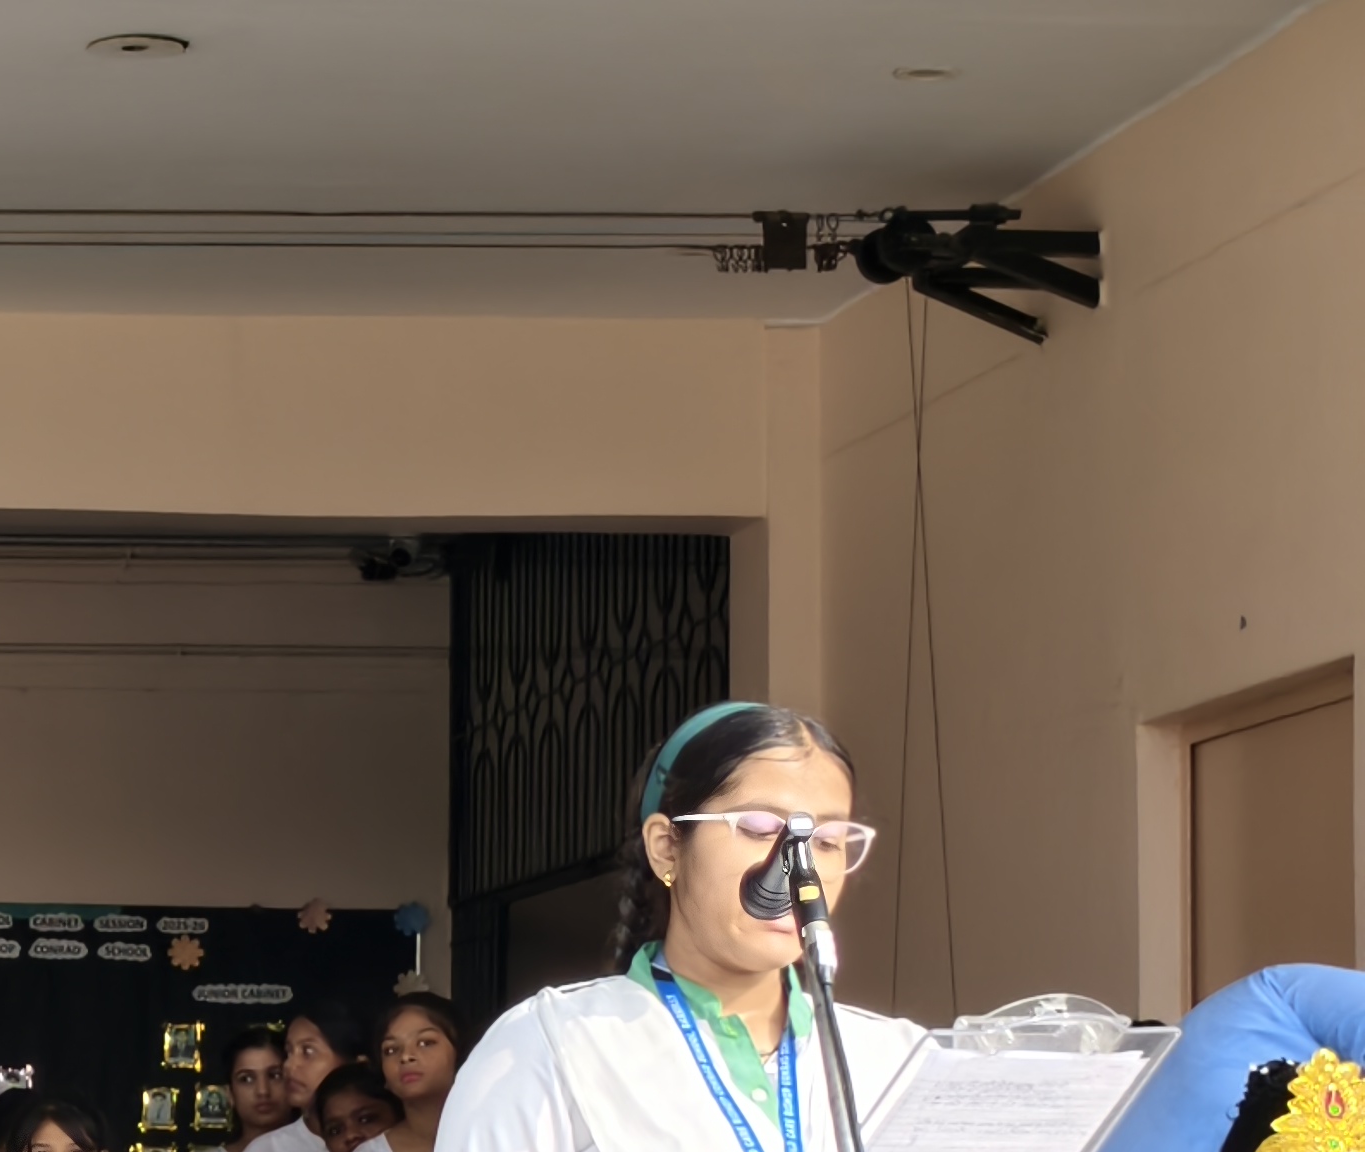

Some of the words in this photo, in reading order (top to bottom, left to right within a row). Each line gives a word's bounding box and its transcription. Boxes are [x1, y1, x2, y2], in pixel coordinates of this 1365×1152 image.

[32, 917, 80, 928] CABINET
[98, 918, 144, 929] SESSION
[34, 944, 81, 954] CONRAD
[104, 946, 148, 957] SCHOOL
